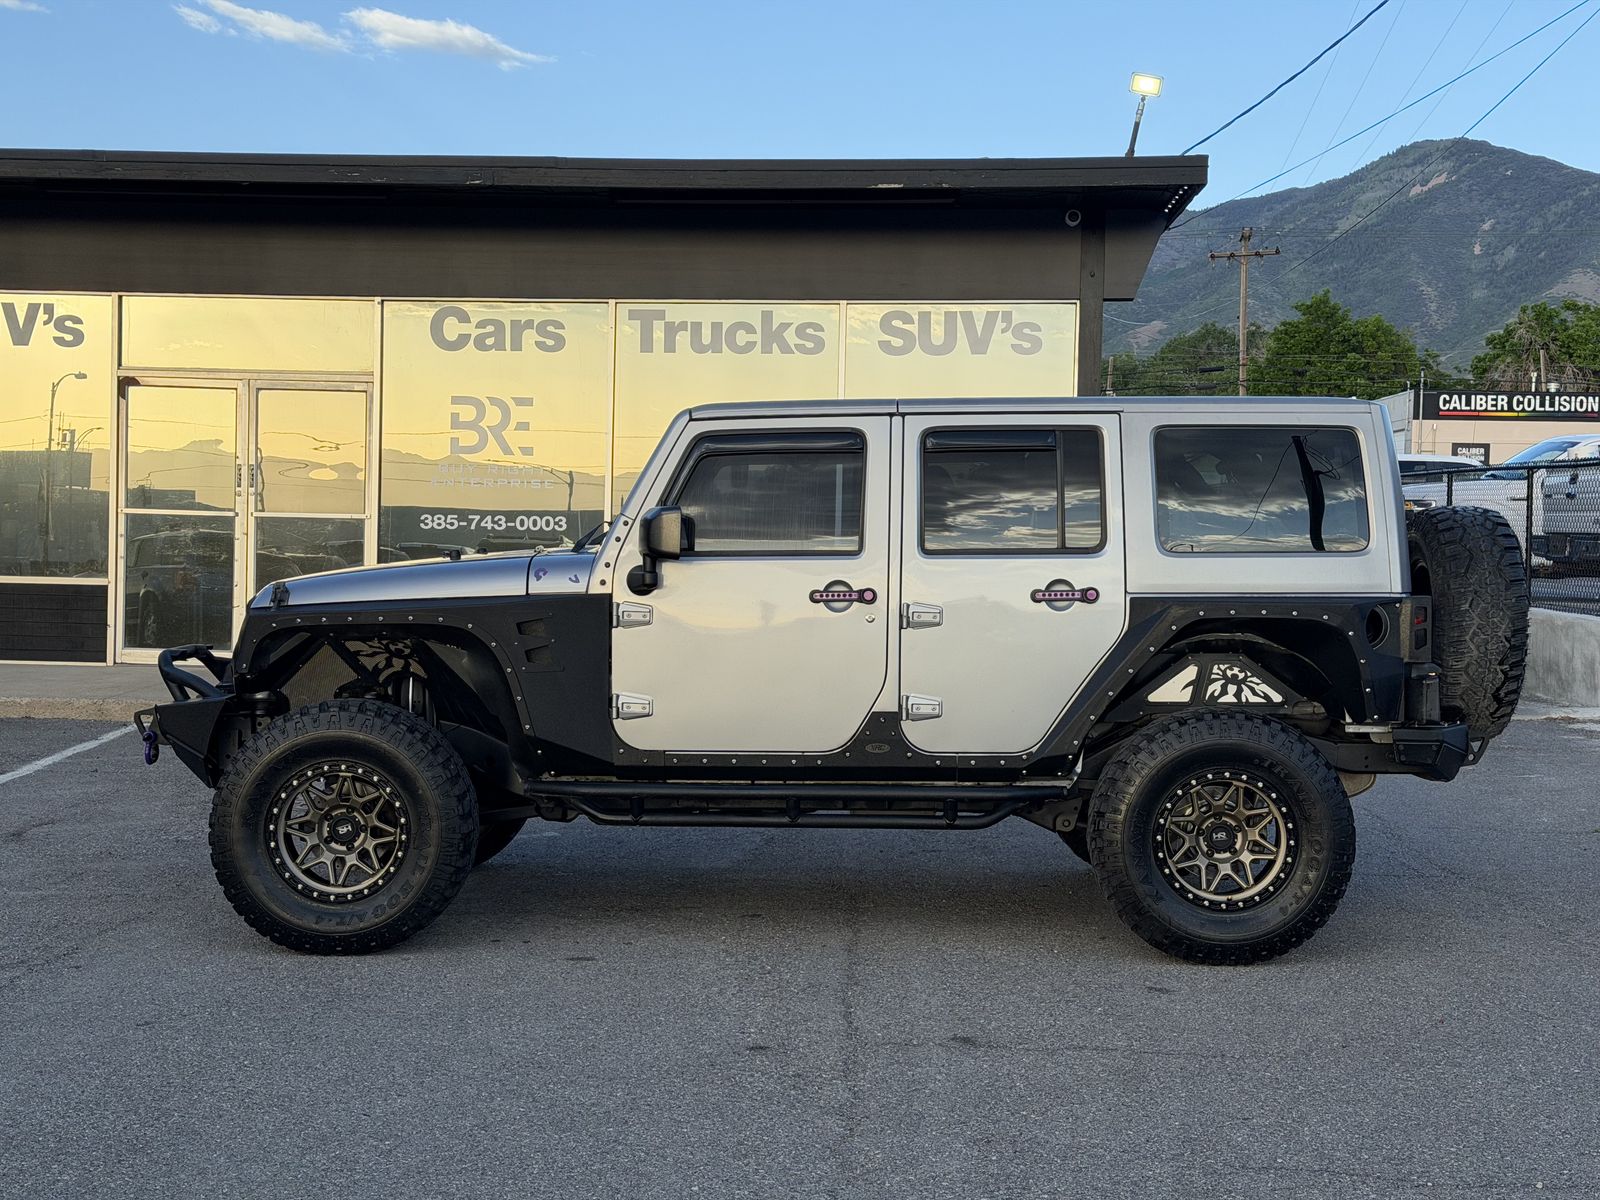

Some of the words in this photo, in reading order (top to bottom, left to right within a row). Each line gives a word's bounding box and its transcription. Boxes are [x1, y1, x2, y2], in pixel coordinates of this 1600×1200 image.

[430, 306, 566, 353] Cars
[628, 309, 826, 355] Trucks
[877, 310, 1043, 356] SUV's
[1439, 394, 1508, 411] CALIBER
[1512, 395, 1599, 412] COLLISION
[450, 395, 534, 456] BRE
[1457, 447, 1485, 455] CALIBER
[438, 463, 478, 475] BUY
[488, 464, 544, 476] RIGHT
[431, 477, 555, 489] ENTERPRISE
[419, 514, 567, 532] 385-743-0003
